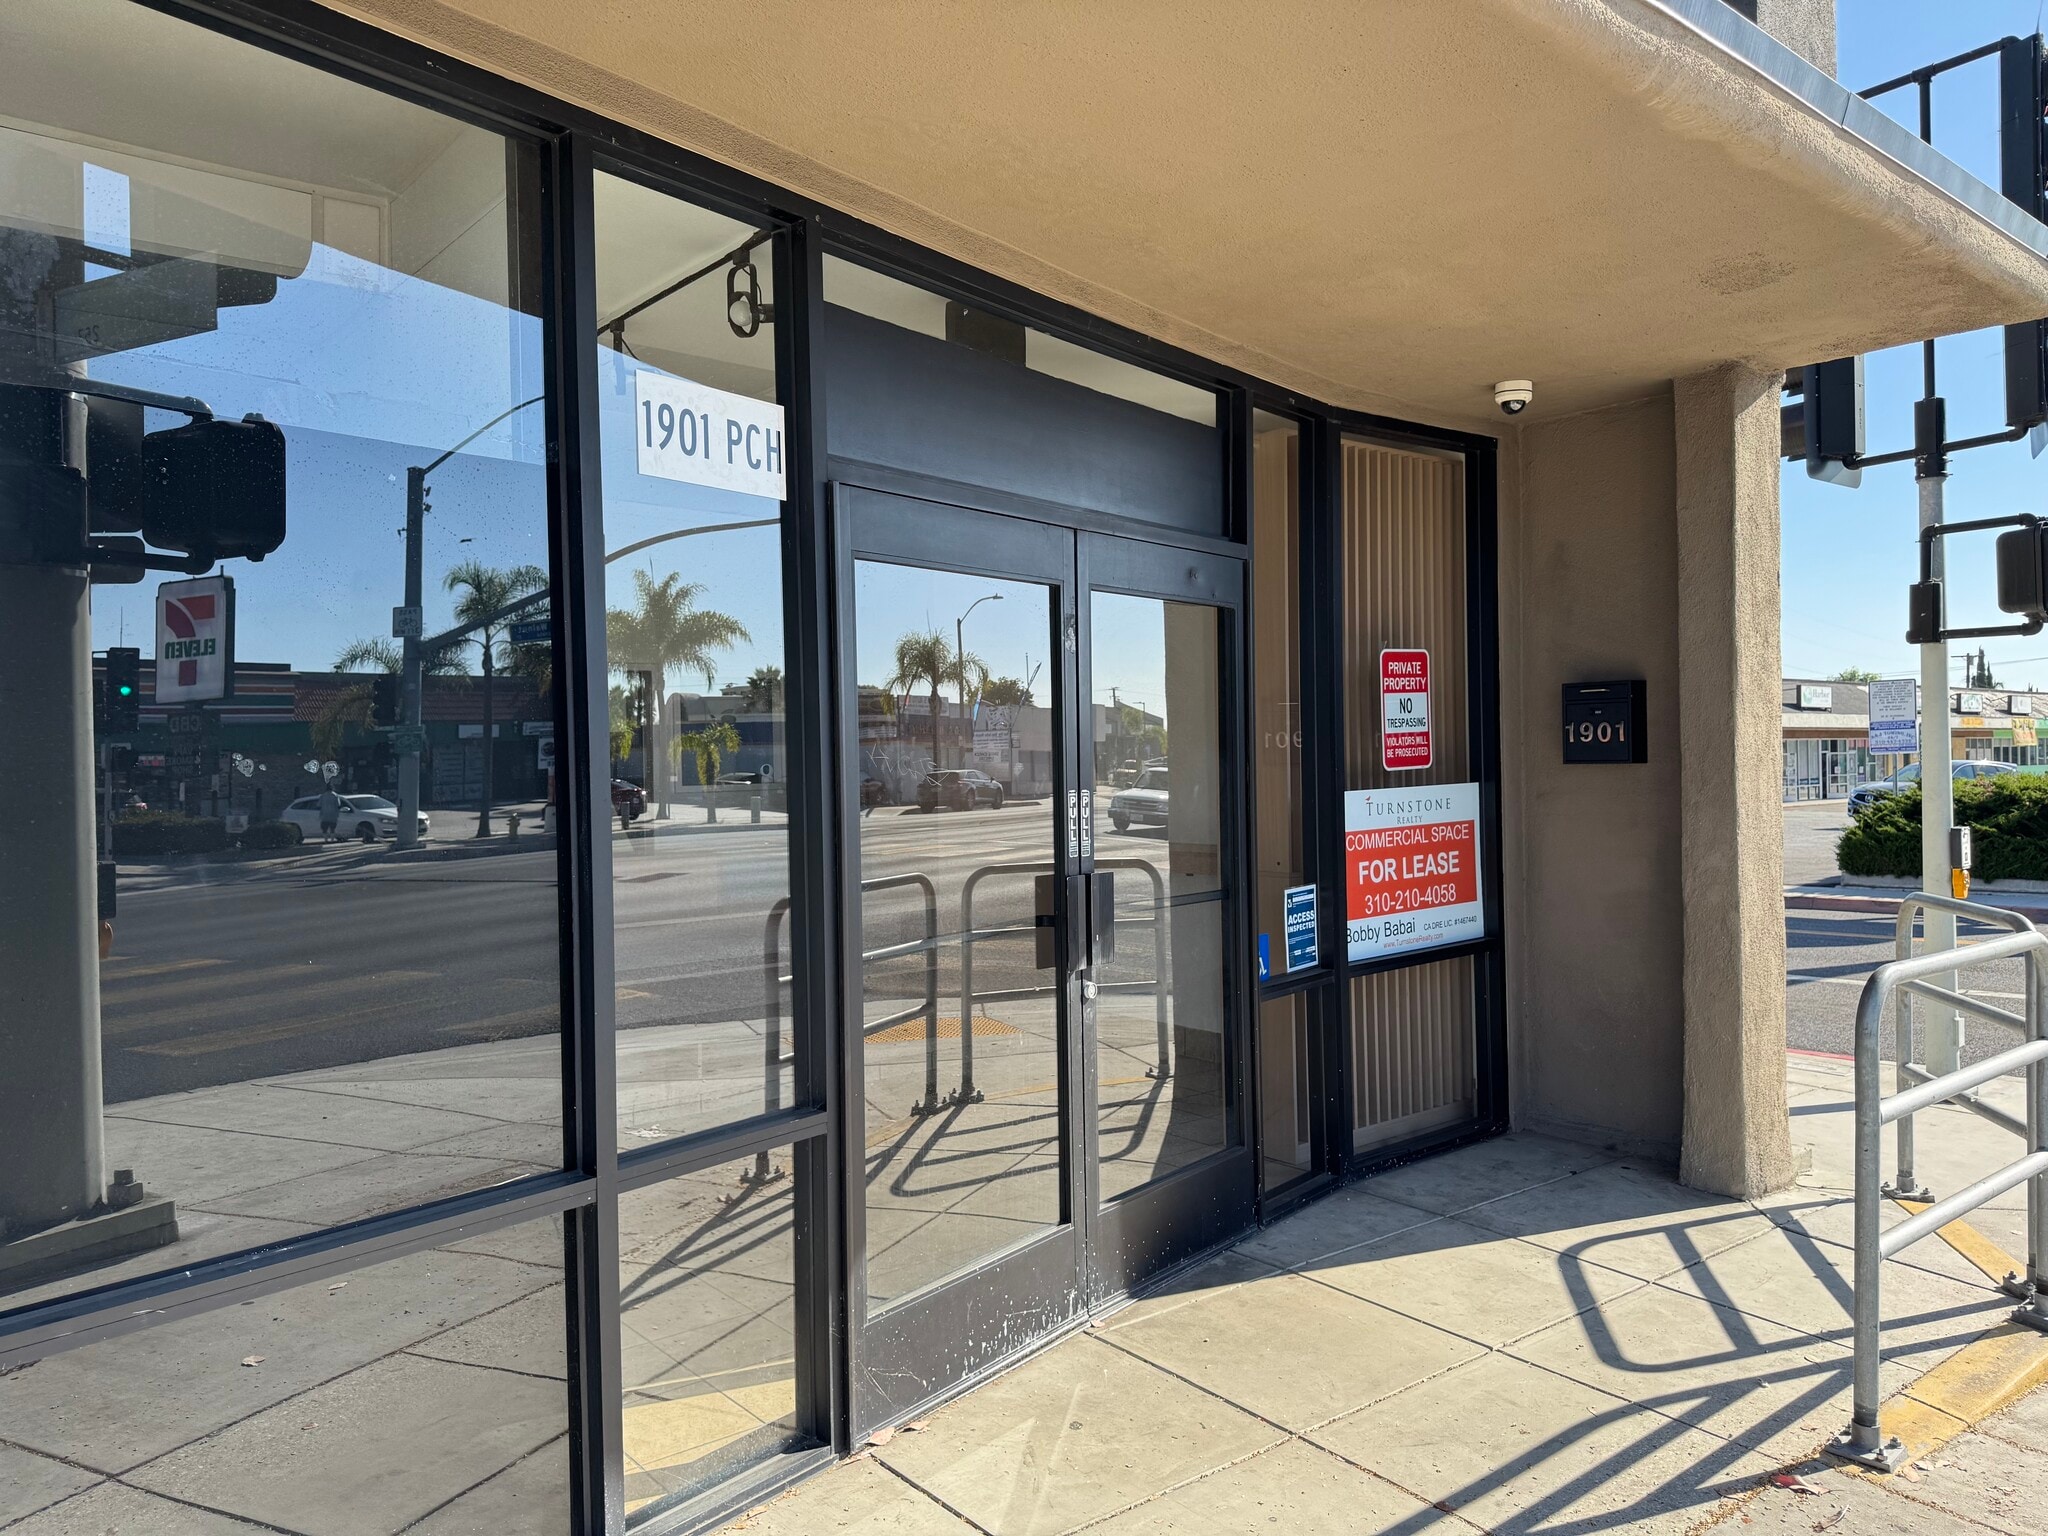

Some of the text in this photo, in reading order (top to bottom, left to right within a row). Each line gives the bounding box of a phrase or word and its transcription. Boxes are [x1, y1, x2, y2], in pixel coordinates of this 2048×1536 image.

[642, 400, 782, 475] 1901 PCH
[1388, 661, 1422, 675] PRIVATE
[1384, 677, 1427, 691] PROPERTY
[1399, 698, 1413, 714] NO
[1387, 717, 1427, 729] TRESPASSING
[1565, 721, 1625, 743] 1901
[1386, 735, 1428, 746] VIOLATORS WILL
[1386, 746, 1429, 758] BE PROSECUTED
[1366, 797, 1452, 817] TURNSTONE
[1396, 815, 1423, 825] REALTY
[1345, 824, 1470, 851] COMMERCIAL SPACE
[1358, 851, 1460, 885] FOR LEASE
[1364, 883, 1457, 915] 310-210-4058
[1288, 909, 1315, 926] ACCESS
[1287, 920, 1315, 934] INSPECTED
[1346, 924, 1381, 944] Bobby
[1384, 917, 1416, 938] Babai
